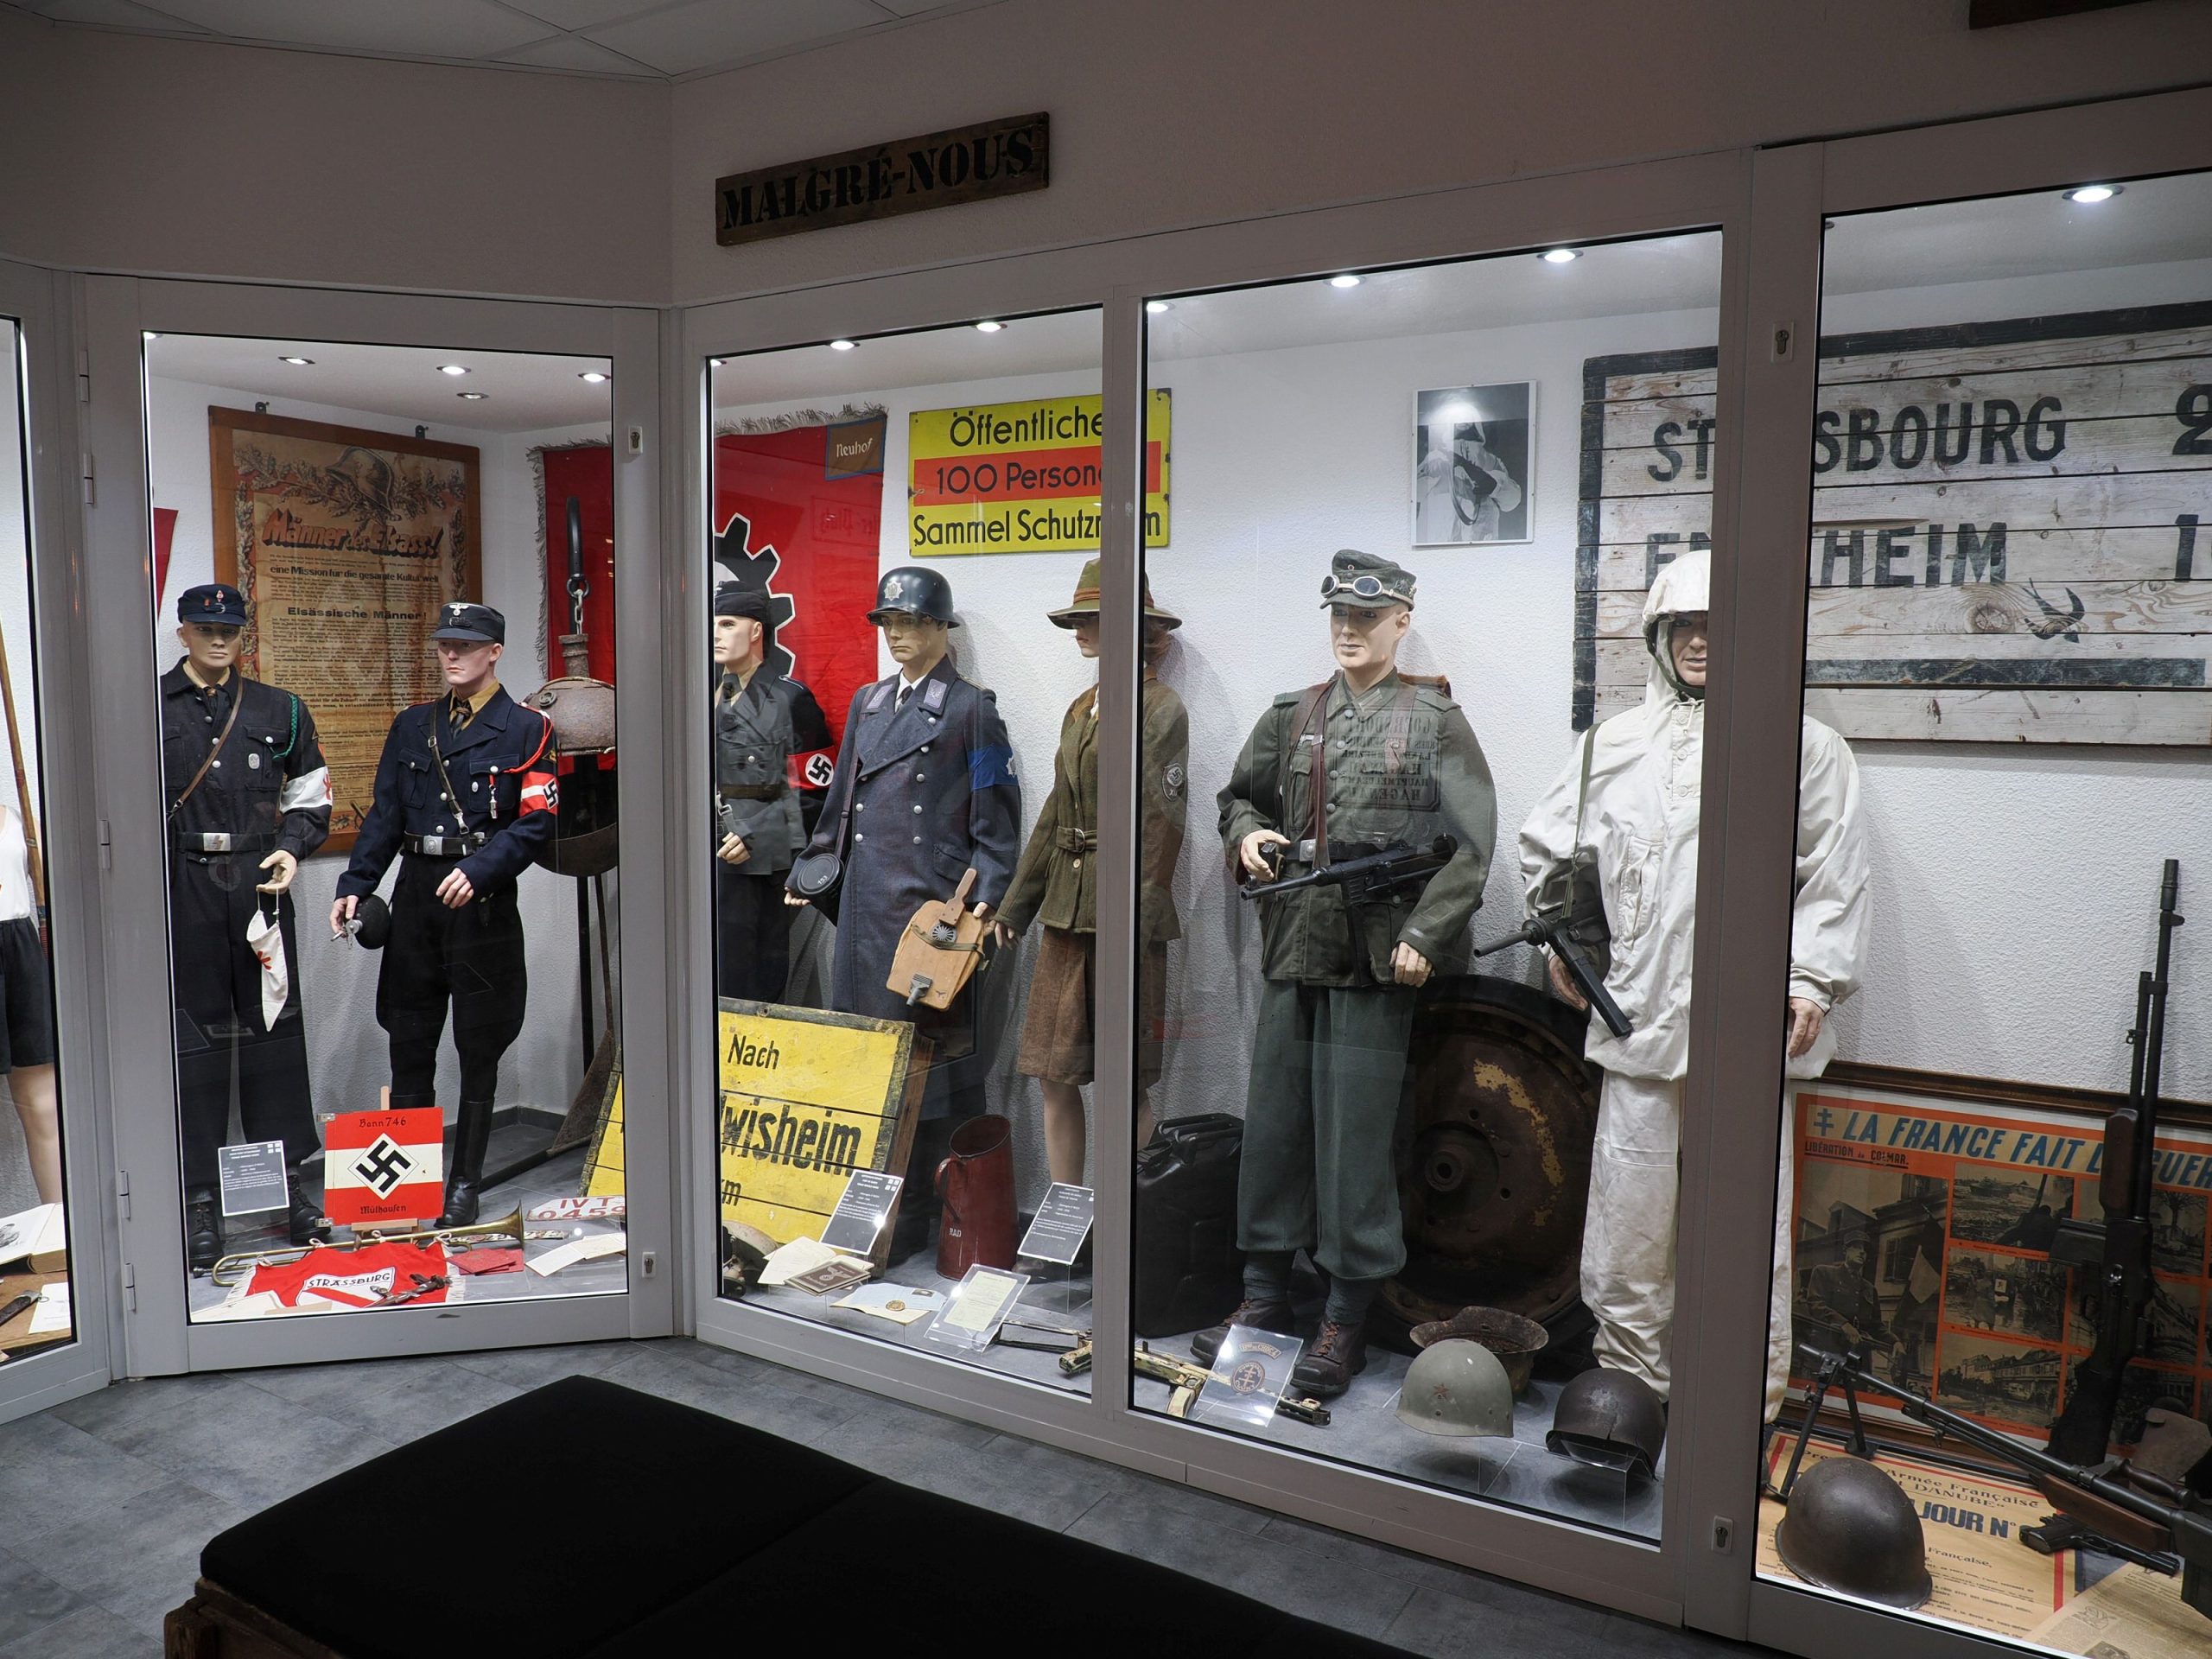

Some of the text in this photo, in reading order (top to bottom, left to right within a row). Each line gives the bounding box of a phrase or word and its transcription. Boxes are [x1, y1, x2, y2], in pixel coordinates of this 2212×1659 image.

[722, 128, 1034, 230] MALGRÉ-NOUS
[836, 437, 874, 459] Neuhof
[1648, 397, 2066, 481] STSBOURG
[937, 461, 1102, 495] 100 Person
[263, 509, 346, 550] Männer
[346, 531, 370, 552] des
[914, 511, 1010, 547] Sammel
[1018, 509, 1160, 541] Schutzrm
[270, 565, 289, 574] eine
[291, 566, 327, 576] Mission
[344, 569, 358, 578] die
[1645, 522, 2007, 589] EHEIM
[288, 607, 368, 620] Elsässische
[728, 1033, 780, 1070] Nach
[359, 1116, 407, 1128] Bann 746
[721, 1096, 861, 1177] wisheim
[1804, 1141, 1853, 1157] LIBÉRATION
[1843, 1111, 1878, 1143] LA
[1888, 1117, 2006, 1160] FRANCE
[2010, 1134, 2087, 1174] FAIT
[559, 1198, 616, 1210] IV T
[949, 1227, 962, 1238] RAD
[308, 1273, 391, 1288] STRASSBURG
[1950, 1483, 2039, 1509] Française
[1918, 1501, 1984, 1533] JOUR
